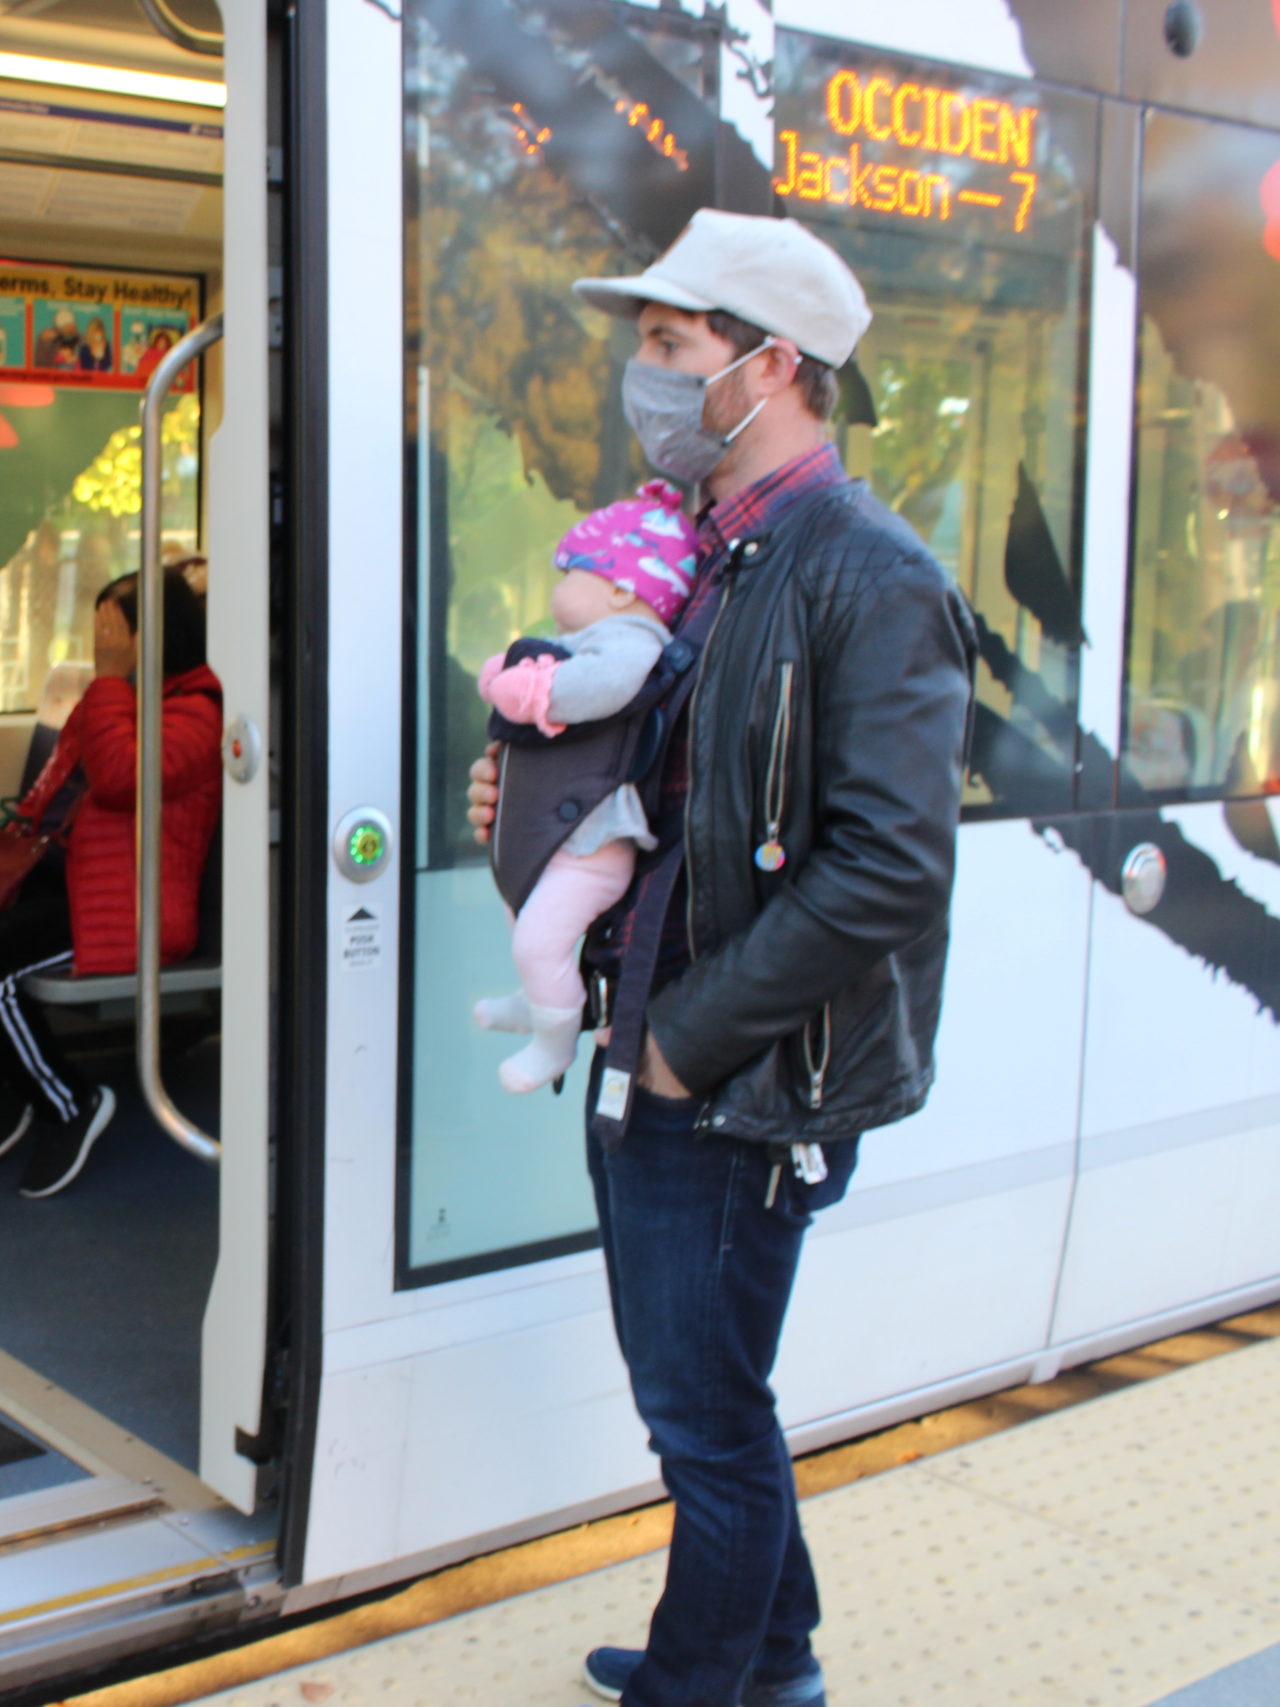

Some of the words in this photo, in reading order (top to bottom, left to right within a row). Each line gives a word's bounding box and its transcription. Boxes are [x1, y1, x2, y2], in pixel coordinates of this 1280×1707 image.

[826, 69, 1039, 168] OCCIDEN
[64, 275, 108, 304] Stay
[113, 280, 192, 309] Healthy!
